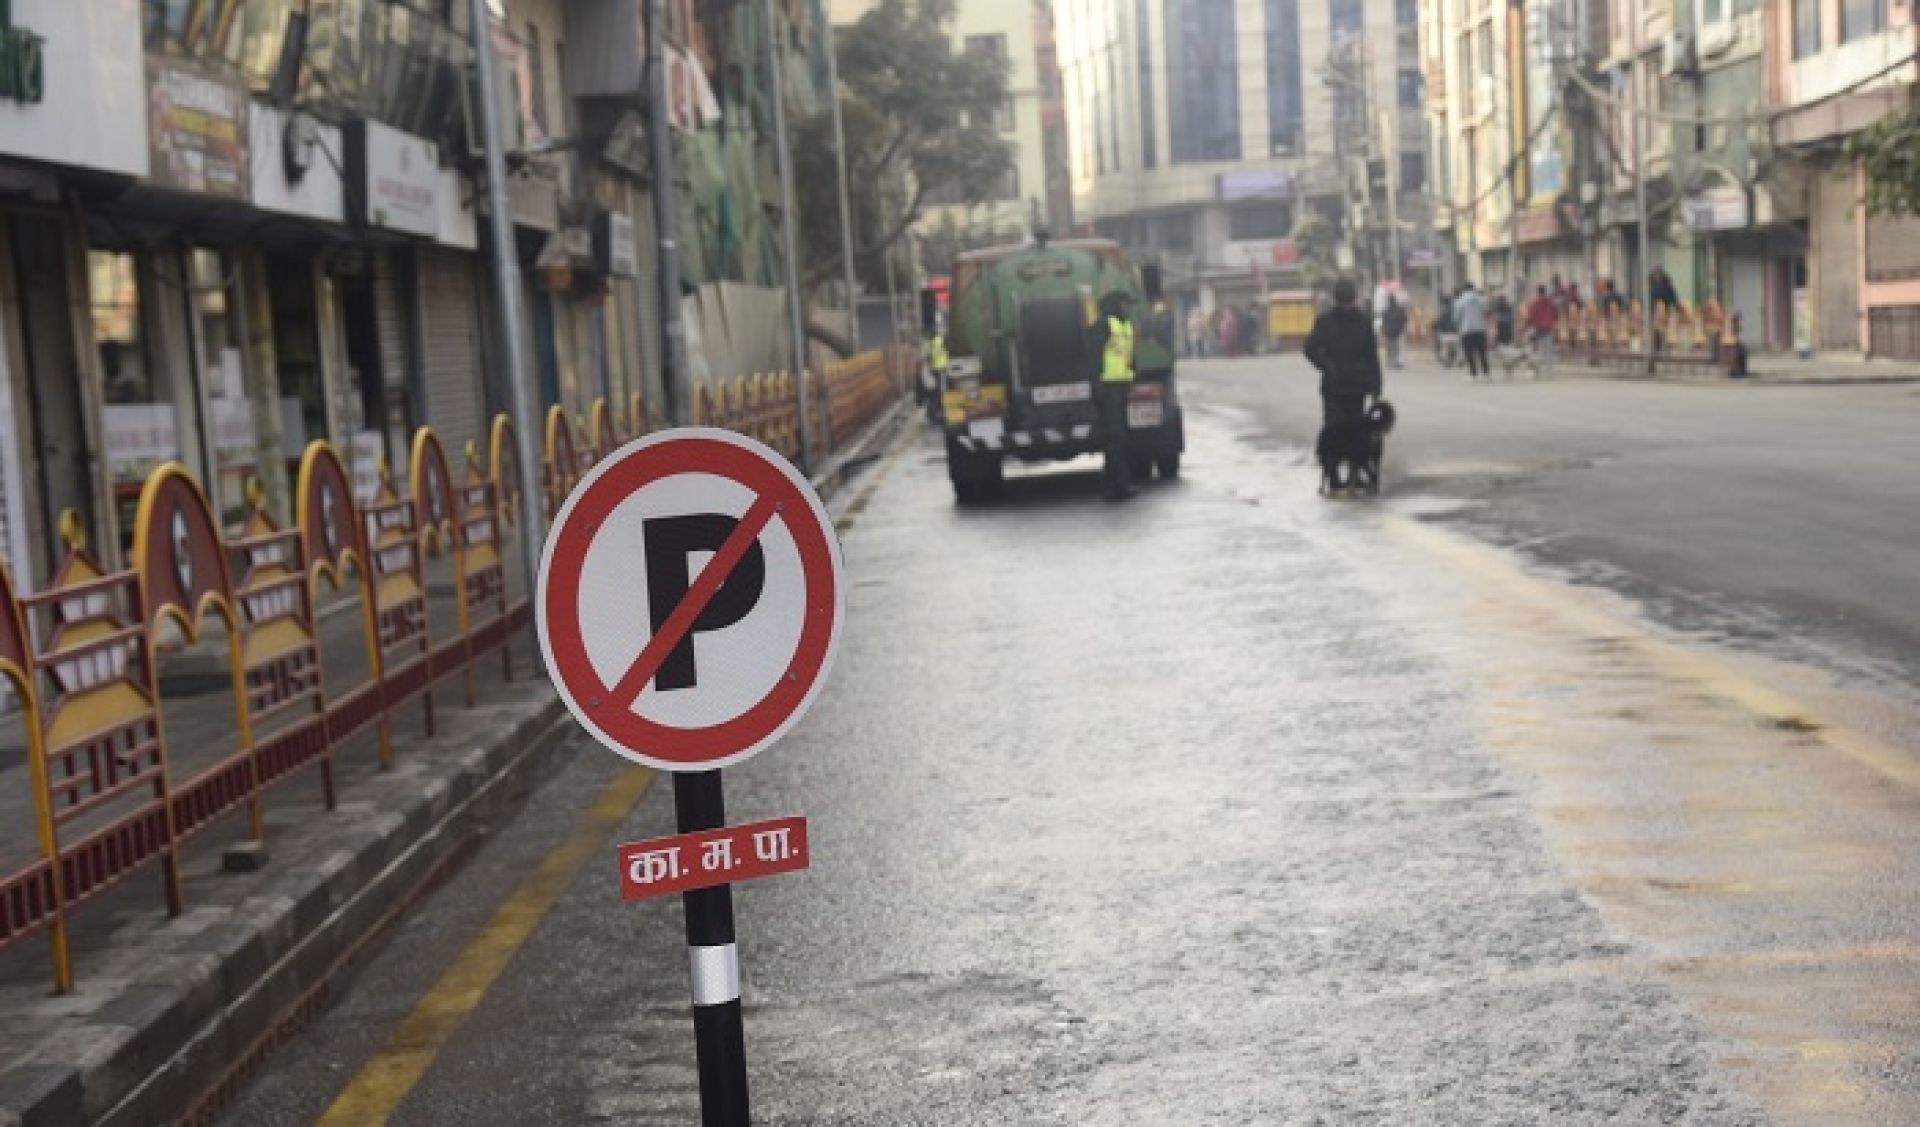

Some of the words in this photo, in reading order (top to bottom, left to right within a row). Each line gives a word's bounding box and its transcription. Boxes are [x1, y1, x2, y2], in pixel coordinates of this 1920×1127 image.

[643, 513, 765, 691] P
[628, 847, 689, 884] का.
[699, 836, 741, 870] म.
[753, 828, 799, 862] पा.
